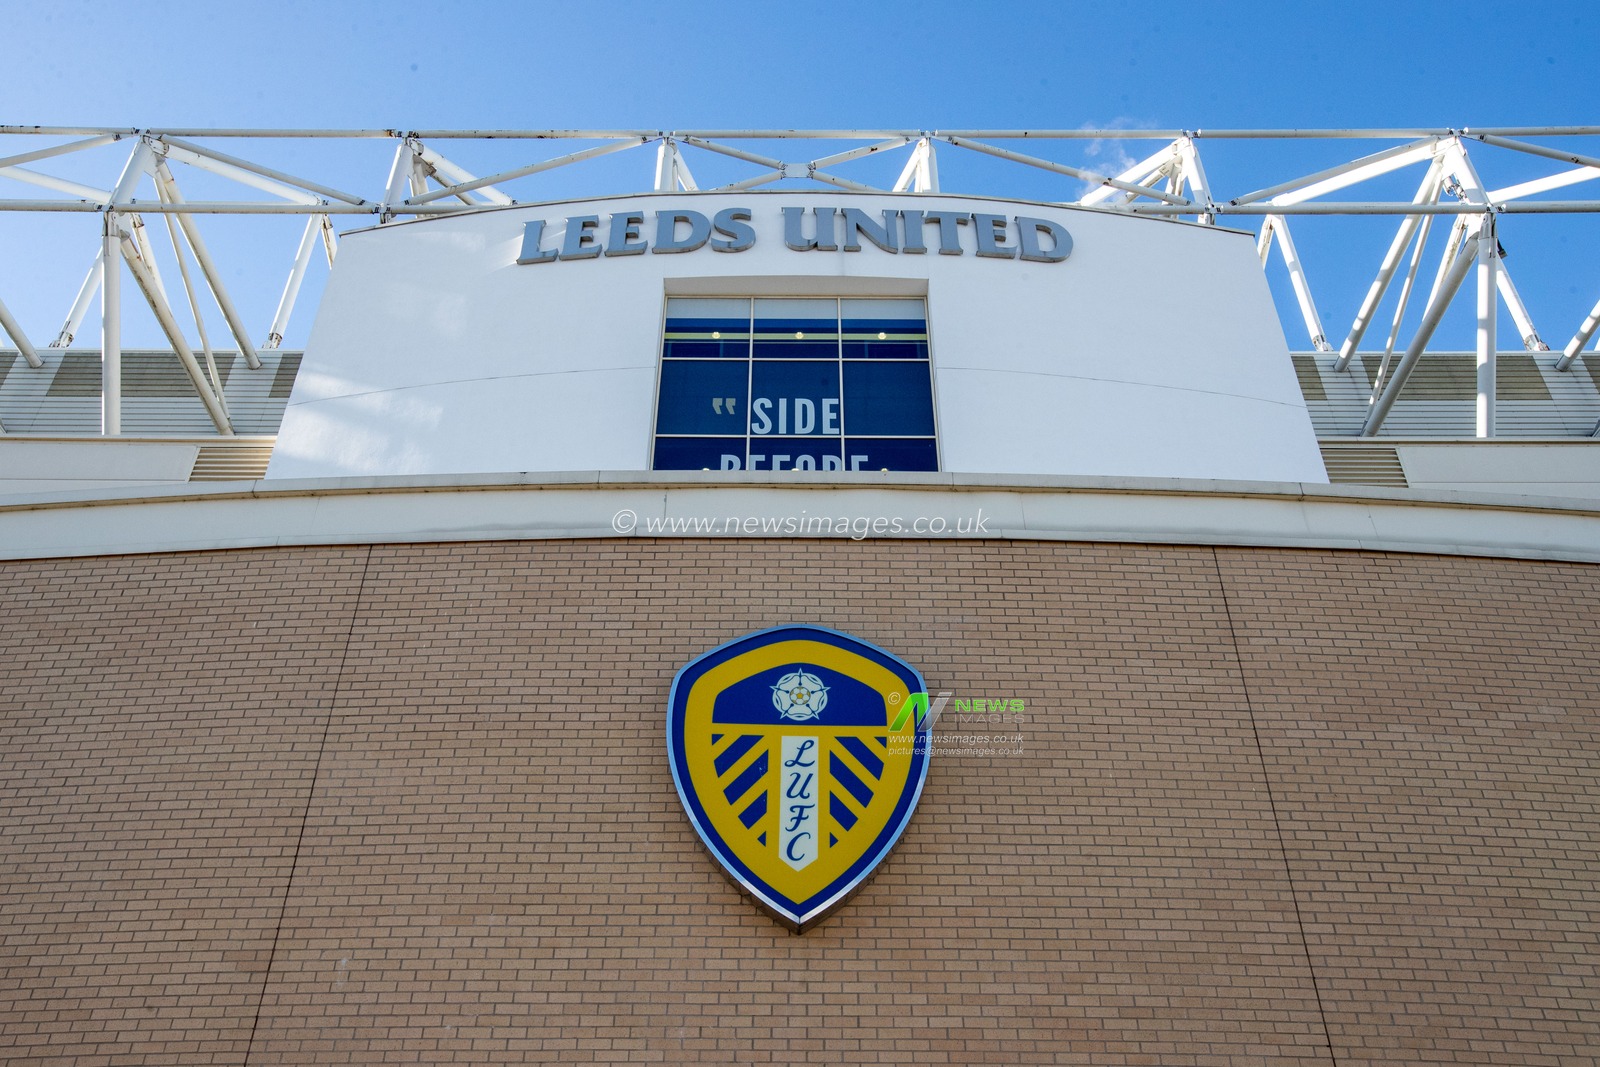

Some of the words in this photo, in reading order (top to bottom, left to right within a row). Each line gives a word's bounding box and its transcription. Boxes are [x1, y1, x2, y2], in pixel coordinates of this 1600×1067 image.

[516, 207, 756, 265] LEEDS
[780, 207, 1074, 263] UNITED
[751, 398, 840, 434] SIDE
